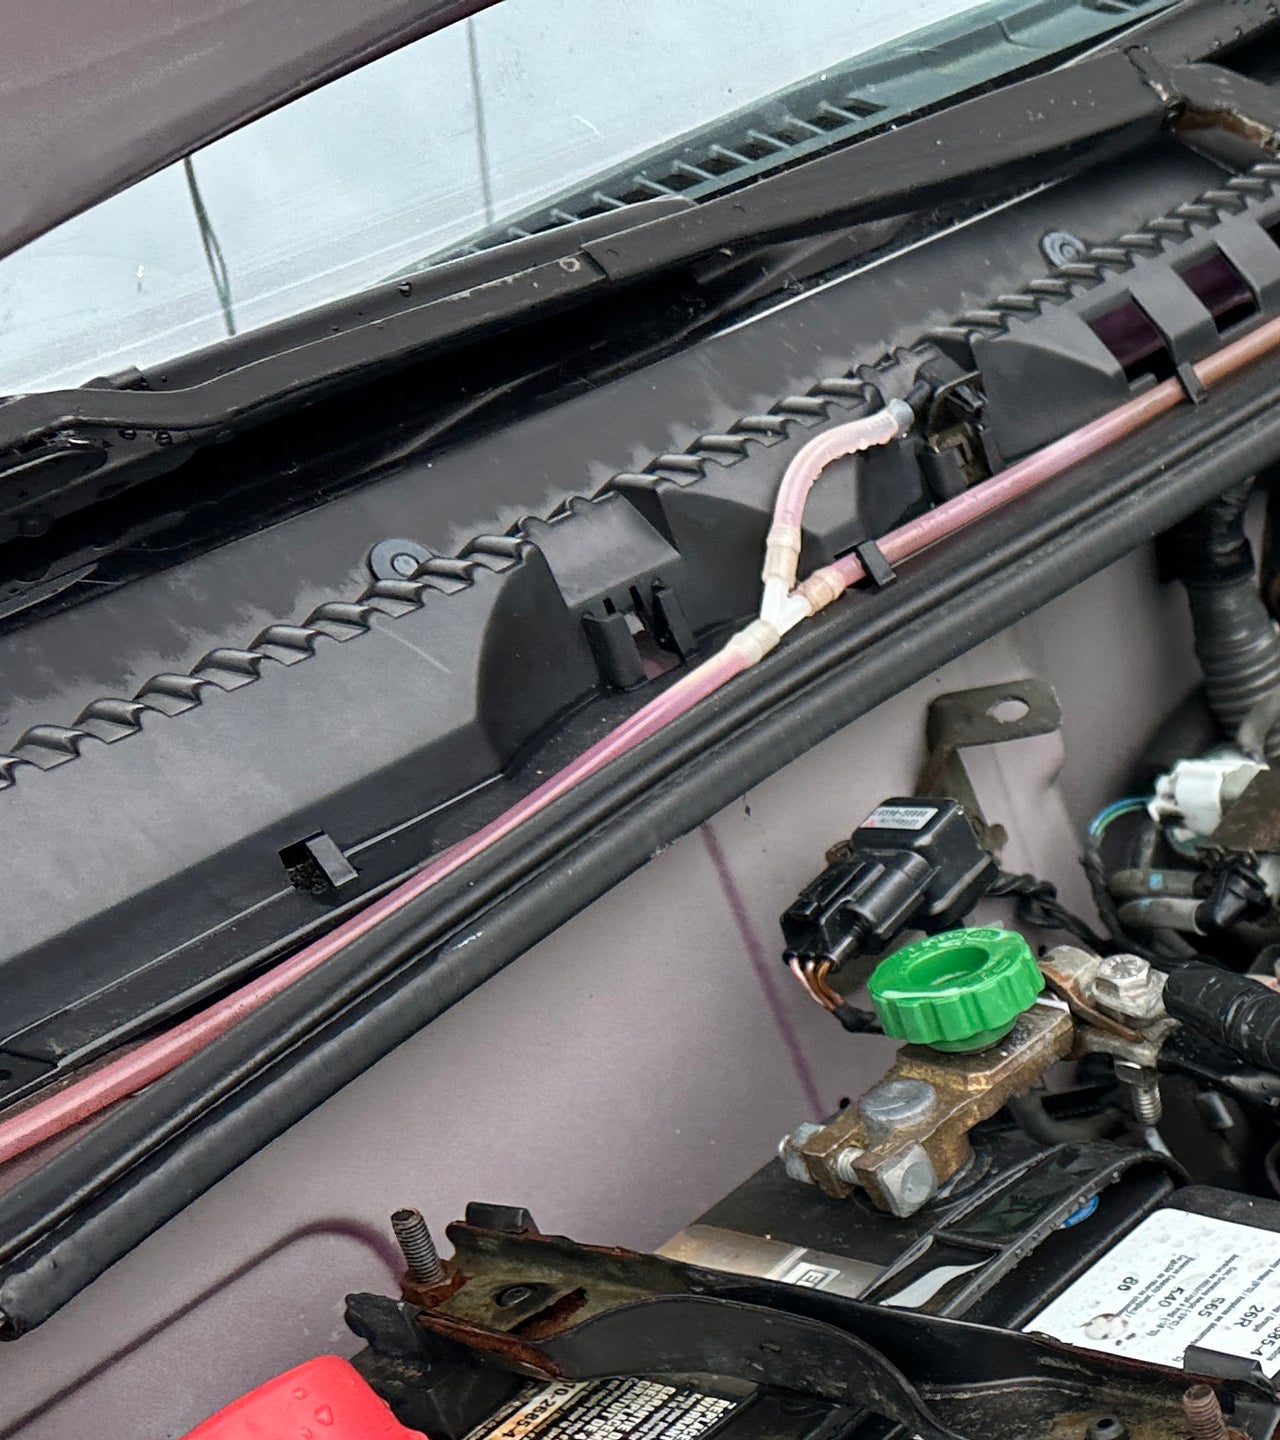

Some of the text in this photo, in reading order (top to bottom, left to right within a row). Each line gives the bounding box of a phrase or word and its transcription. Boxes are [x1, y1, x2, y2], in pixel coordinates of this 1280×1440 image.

[1112, 1275, 1141, 1292] 80
[1233, 1304, 1266, 1328] 26R
[499, 1383, 577, 1438] 10-2685-4
[598, 1380, 653, 1417] GRATUIT
[613, 1386, 678, 1432] GARANTIE
[571, 1432, 591, 1440] 4
[581, 1418, 608, 1432] DE
